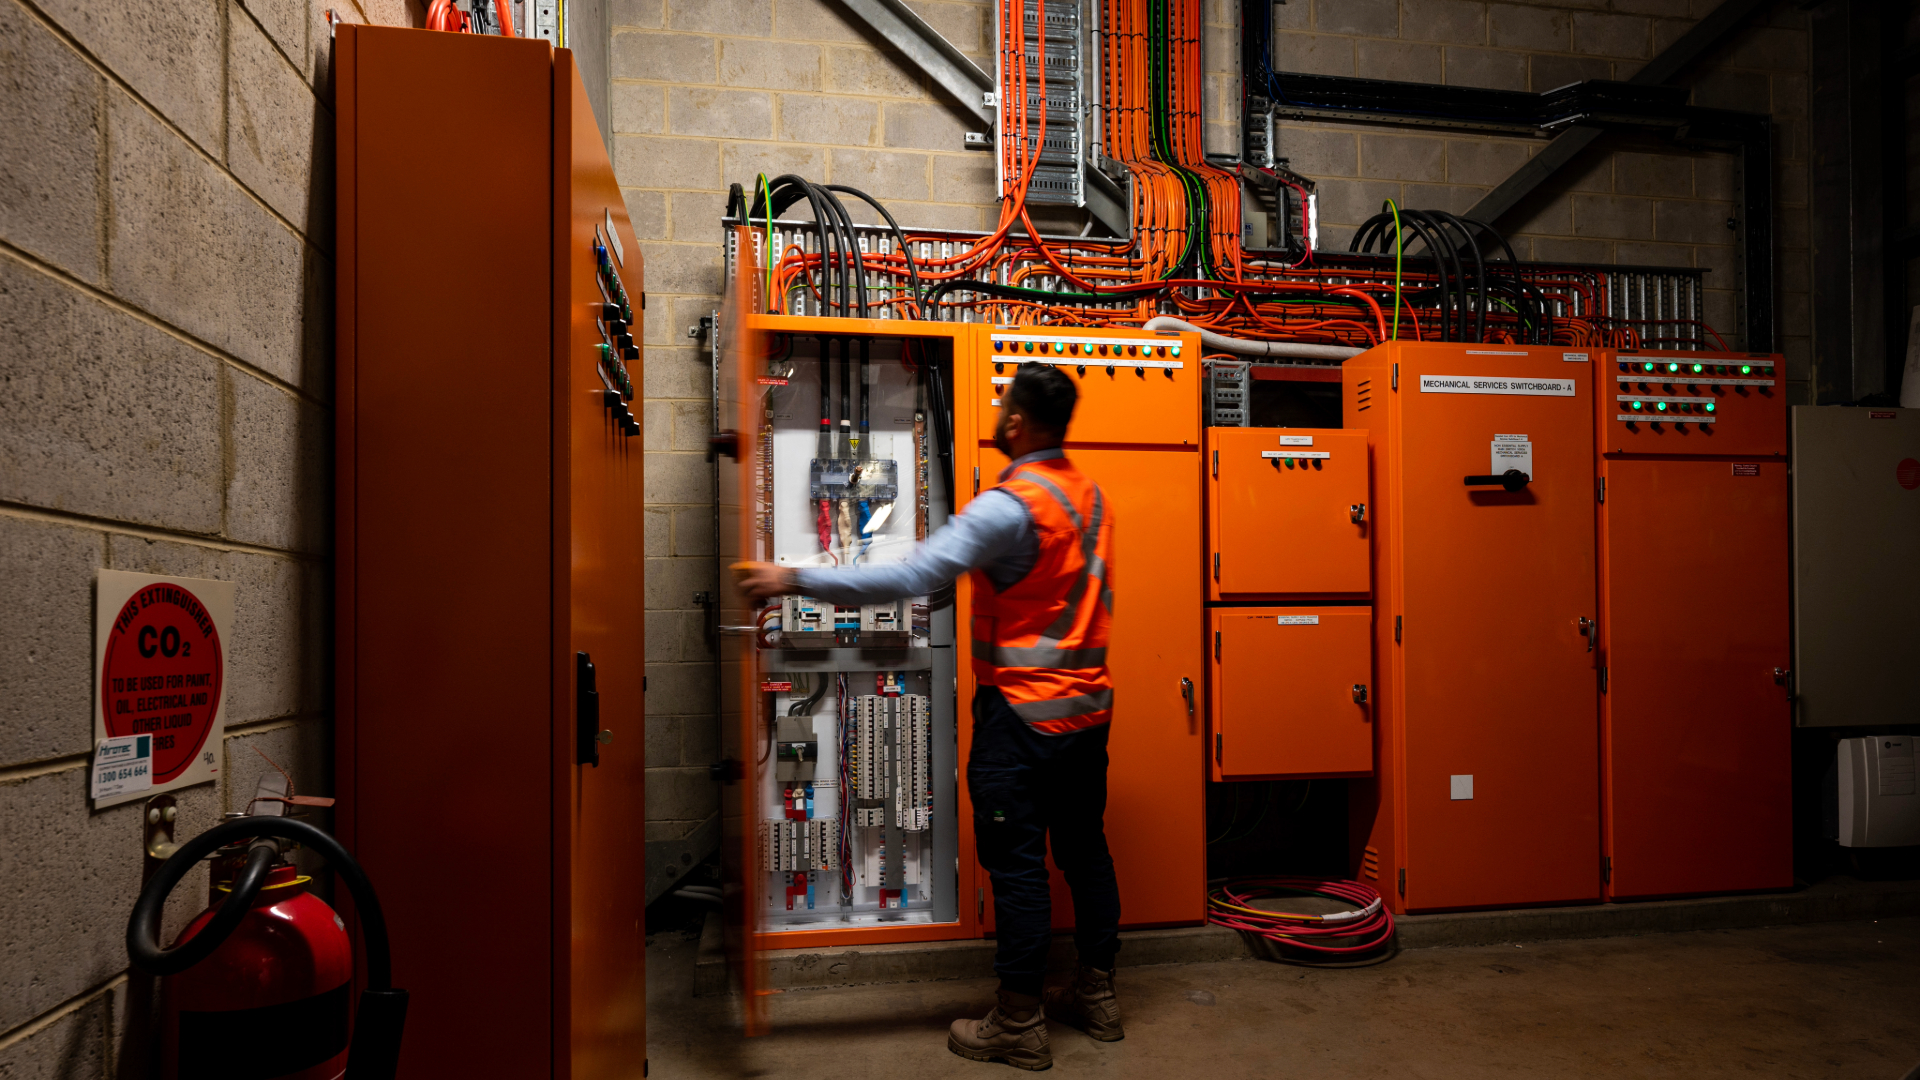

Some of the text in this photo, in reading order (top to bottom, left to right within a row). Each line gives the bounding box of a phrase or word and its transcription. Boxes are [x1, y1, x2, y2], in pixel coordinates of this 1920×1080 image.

[1423, 380, 1470, 388] MECHANICAL
[1474, 381, 1508, 390] SERVICES
[1510, 382, 1561, 391] SWITCHBOARD
[116, 588, 212, 638] THIS EXTINGUISHER
[112, 673, 212, 693] TO BE USED FOR PAINT,
[116, 692, 208, 714] OIL, ELECTRICAL AND
[132, 713, 192, 734] OTHER LIQUID
[98, 770, 116, 784] 1300
[118, 768, 132, 780] 654
[134, 765, 148, 776] 664
